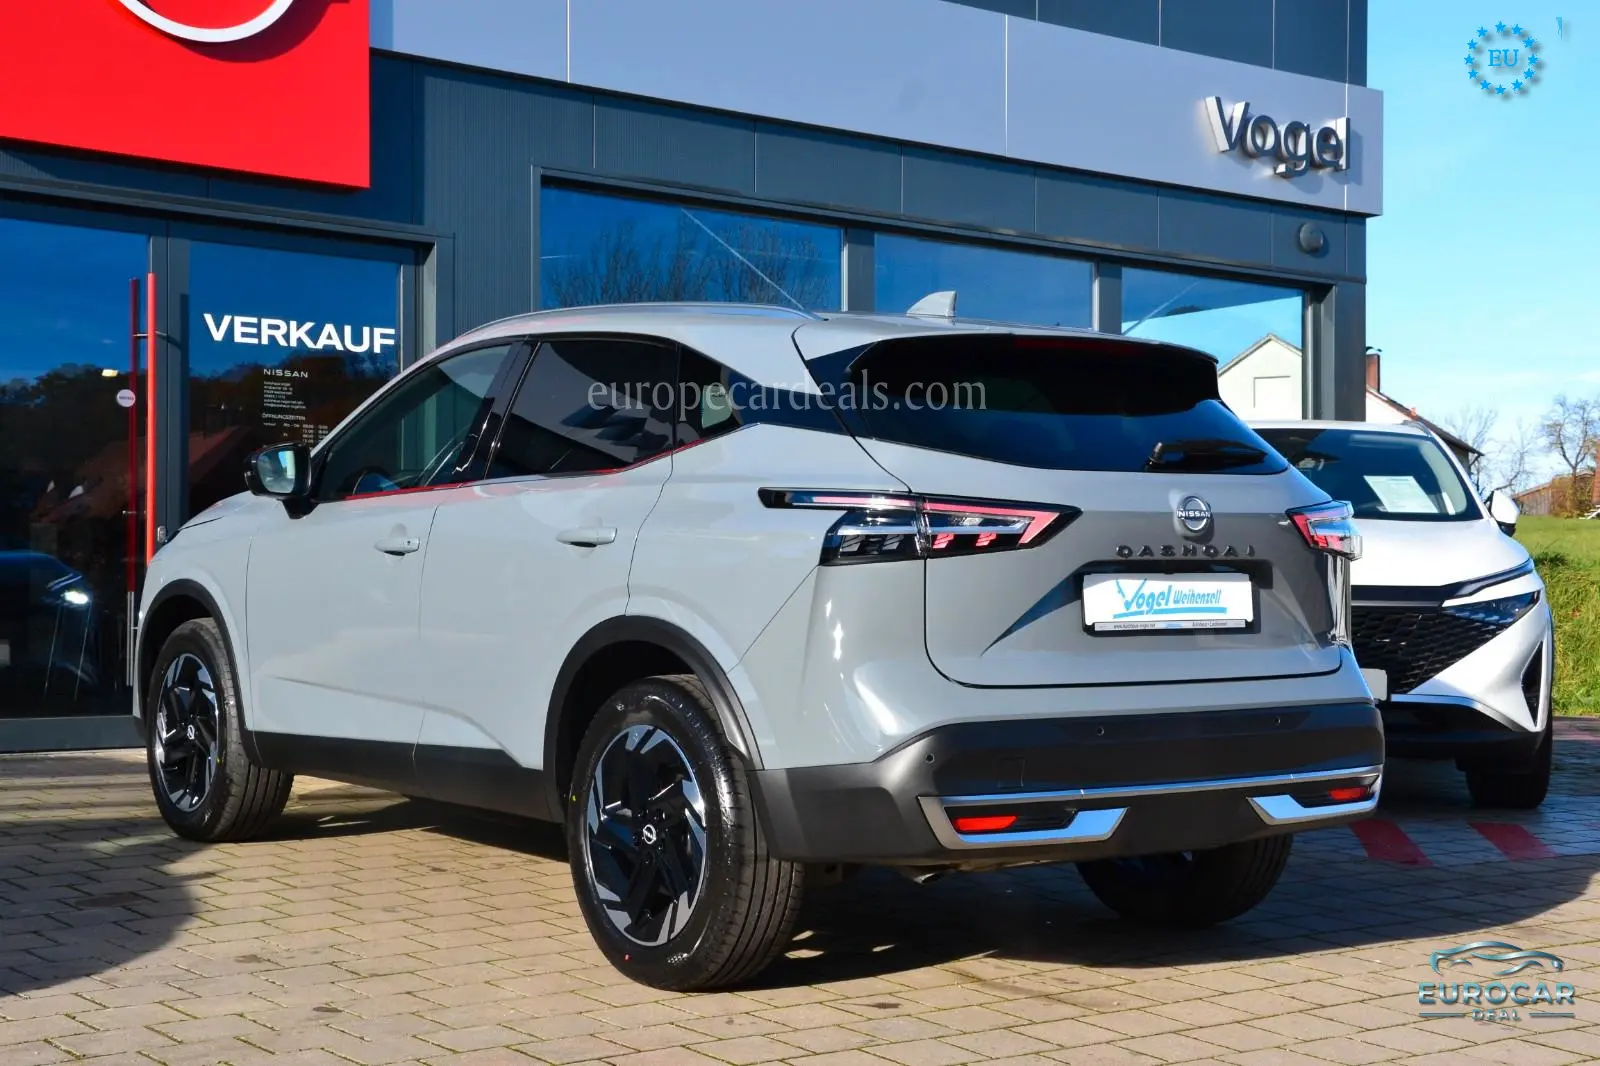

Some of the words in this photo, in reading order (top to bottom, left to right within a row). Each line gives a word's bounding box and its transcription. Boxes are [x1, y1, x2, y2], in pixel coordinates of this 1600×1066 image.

[1204, 95, 1351, 178] Vogel
[203, 313, 396, 354] VERKAUF
[263, 368, 309, 378] NISSAN
[1176, 509, 1212, 519] NISSAN
[1115, 544, 1256, 558] QASHQAI
[1115, 578, 1173, 615] Vogel
[1173, 588, 1222, 605] Weihenzell
